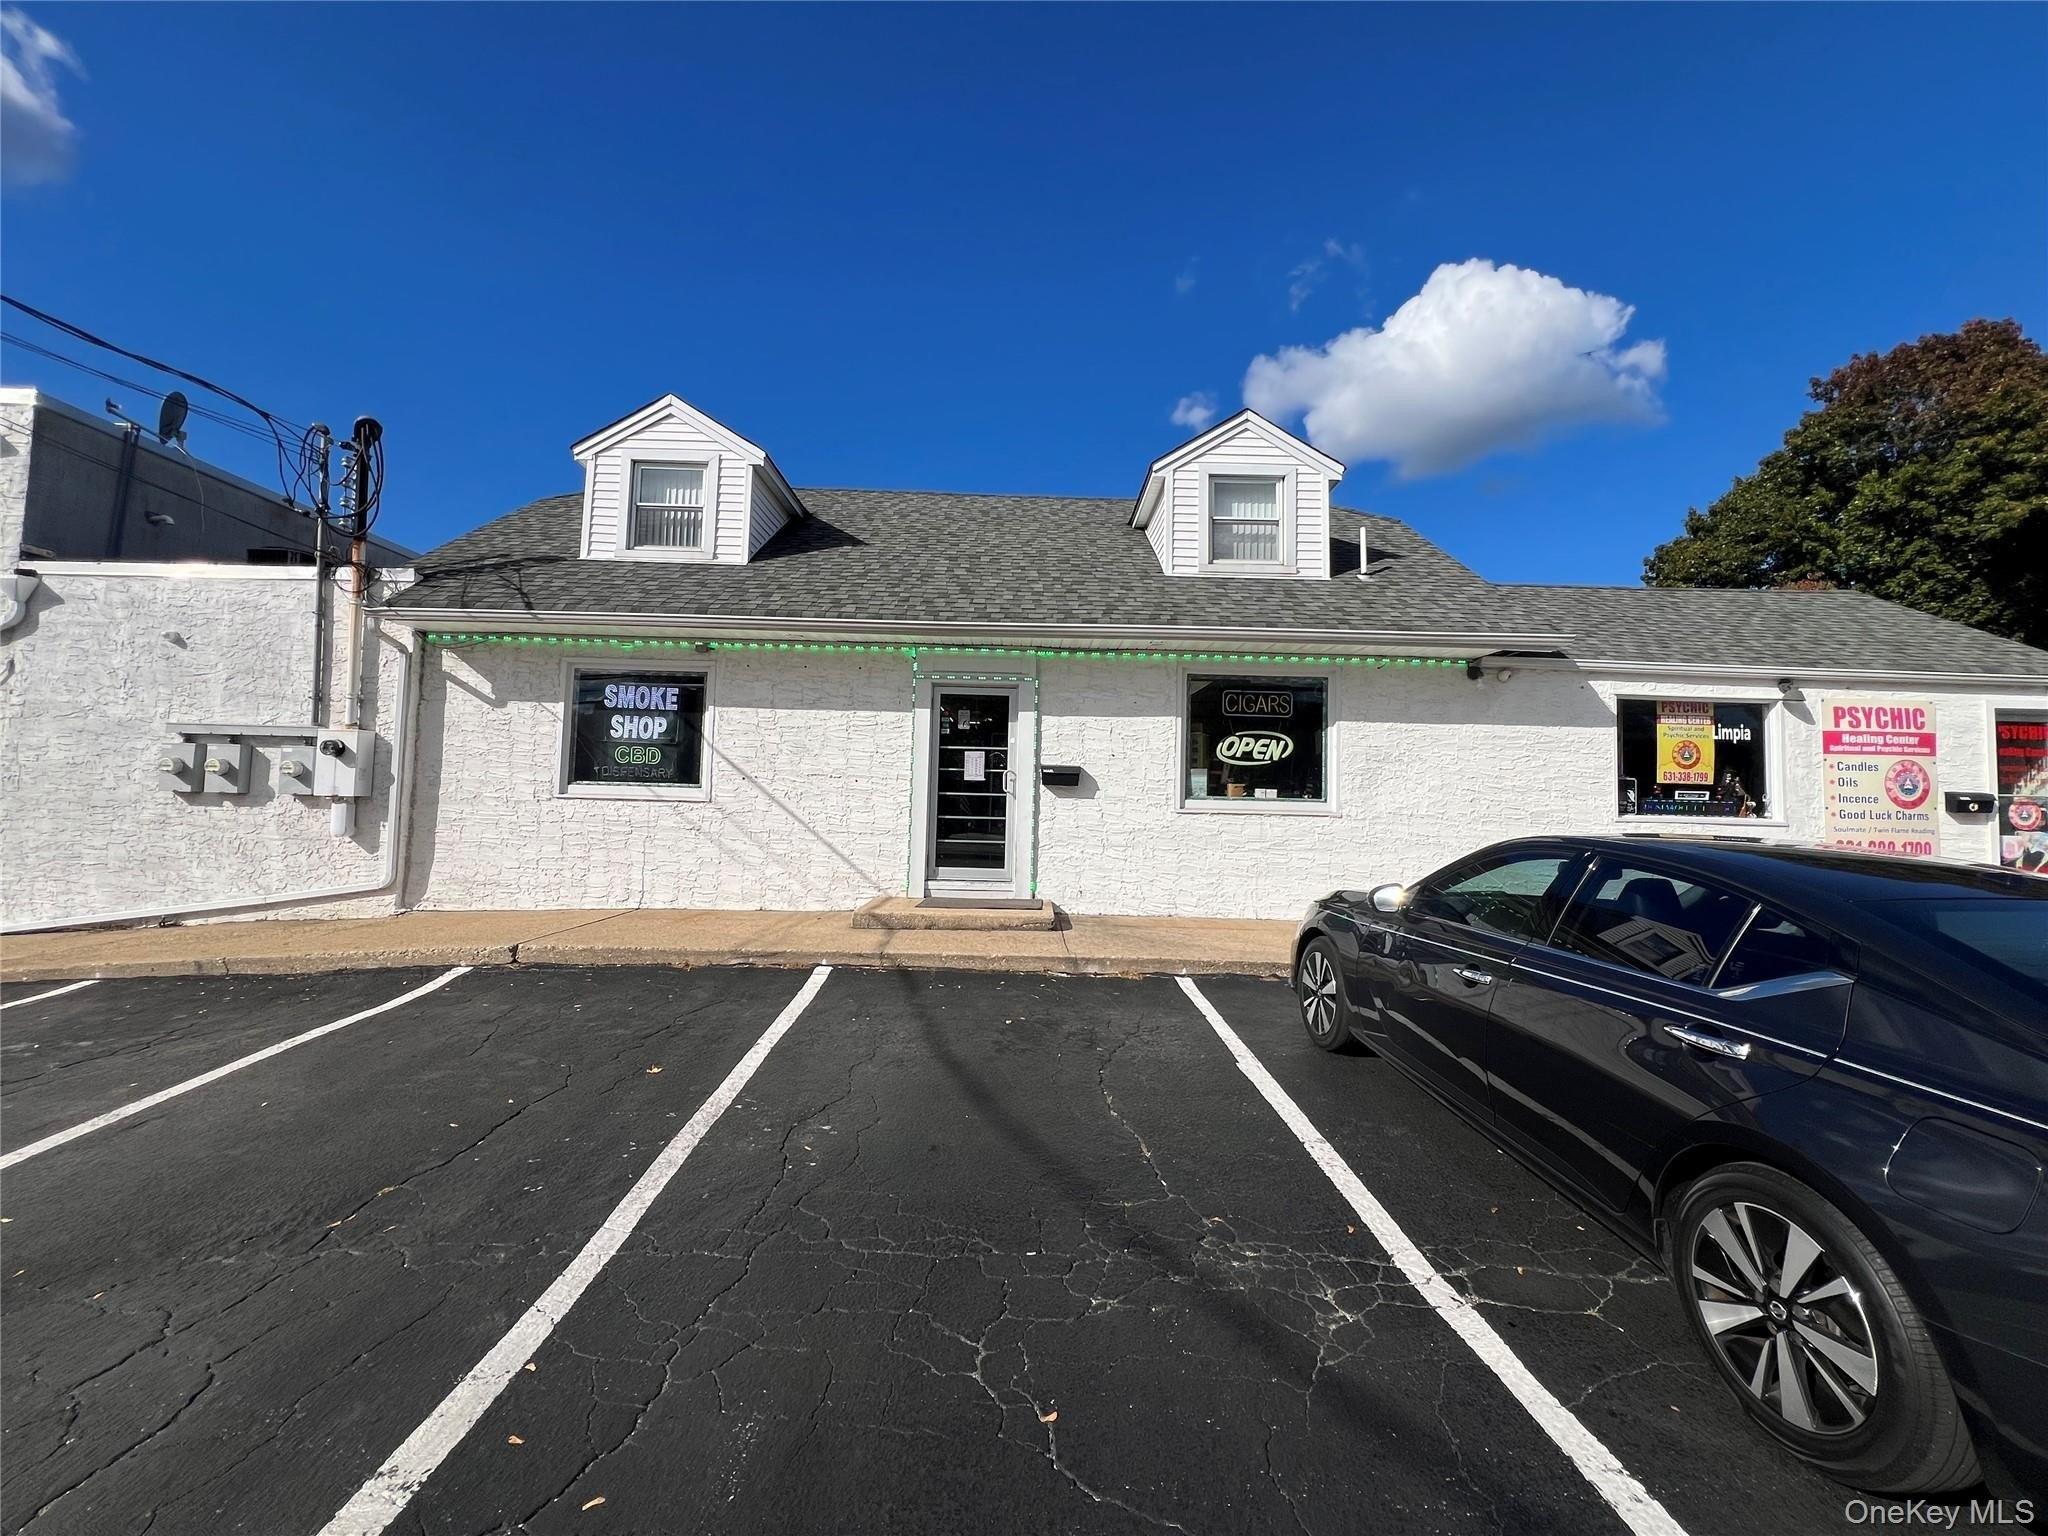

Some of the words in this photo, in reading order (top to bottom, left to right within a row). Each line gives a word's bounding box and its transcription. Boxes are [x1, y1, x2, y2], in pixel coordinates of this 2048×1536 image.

[603, 684, 679, 711] SMOKE
[1225, 693, 1290, 714] CIGARS
[1661, 701, 1709, 714] PSYCHIC
[1832, 706, 1926, 730] PSYCHIC
[610, 714, 668, 740] SHOP
[1713, 723, 1752, 744] Limpia
[1842, 734, 1884, 745] Healing
[1886, 735, 1920, 745] Center
[615, 746, 661, 765] CBD
[1221, 735, 1286, 761] OPEN
[1837, 761, 1879, 772] Candles
[1663, 771, 1709, 782] 631-338-1799
[1838, 777, 1859, 788] Oils
[1838, 793, 1879, 804] Incence
[1839, 809, 1866, 820] Good
[1869, 810, 1892, 821] Luck
[1895, 811, 1930, 821] Charms
